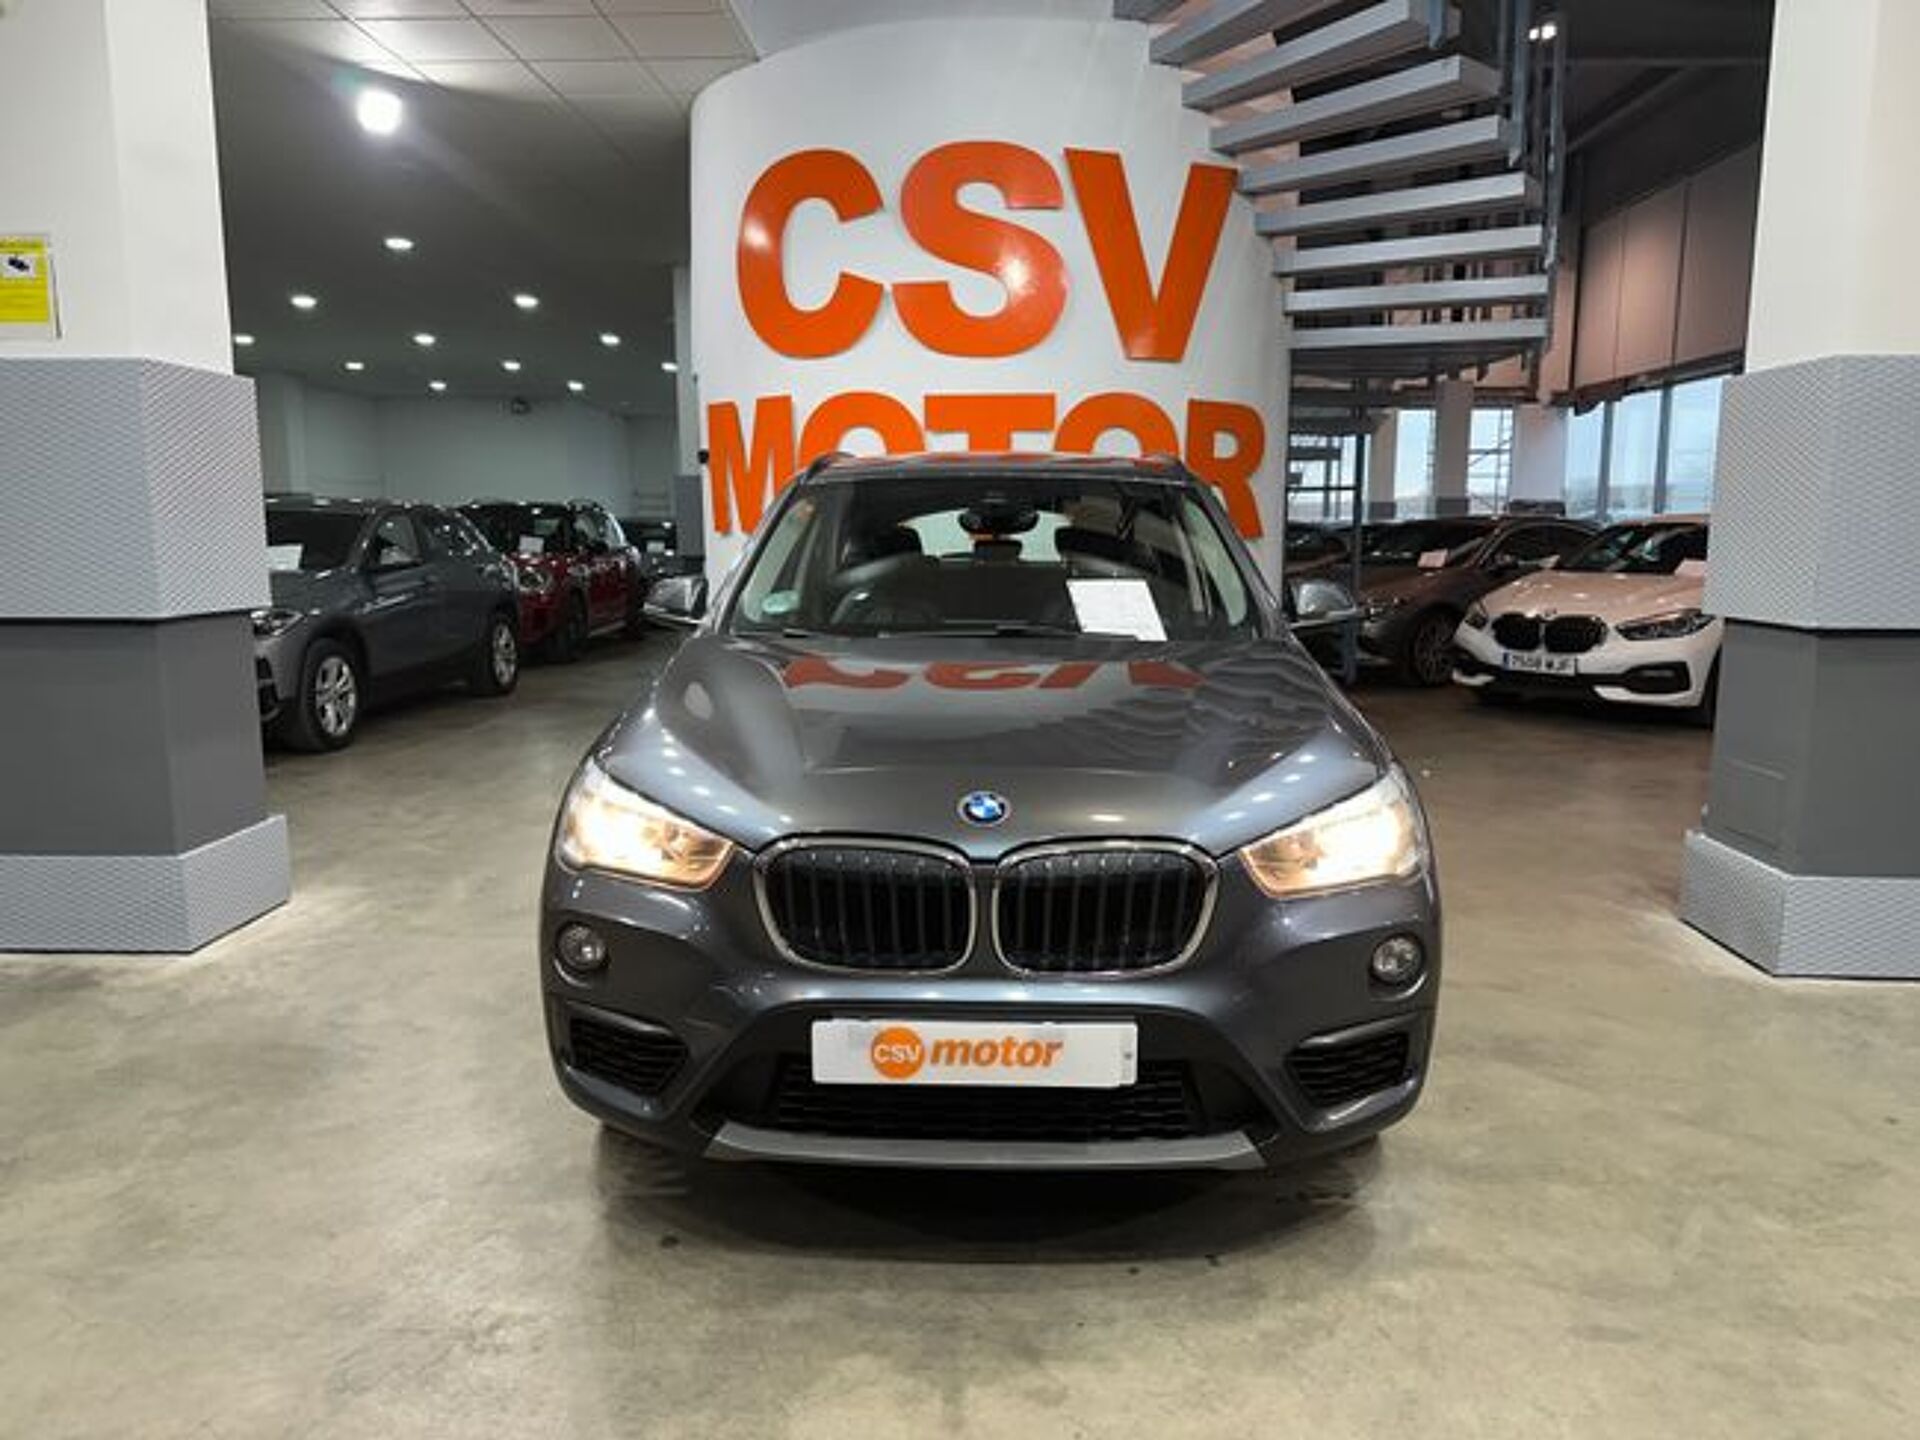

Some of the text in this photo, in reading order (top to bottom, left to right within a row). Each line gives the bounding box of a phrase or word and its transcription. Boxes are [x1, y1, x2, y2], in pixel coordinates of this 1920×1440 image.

[737, 141, 1238, 363] CSV
[873, 1036, 1064, 1068] CSV motor
